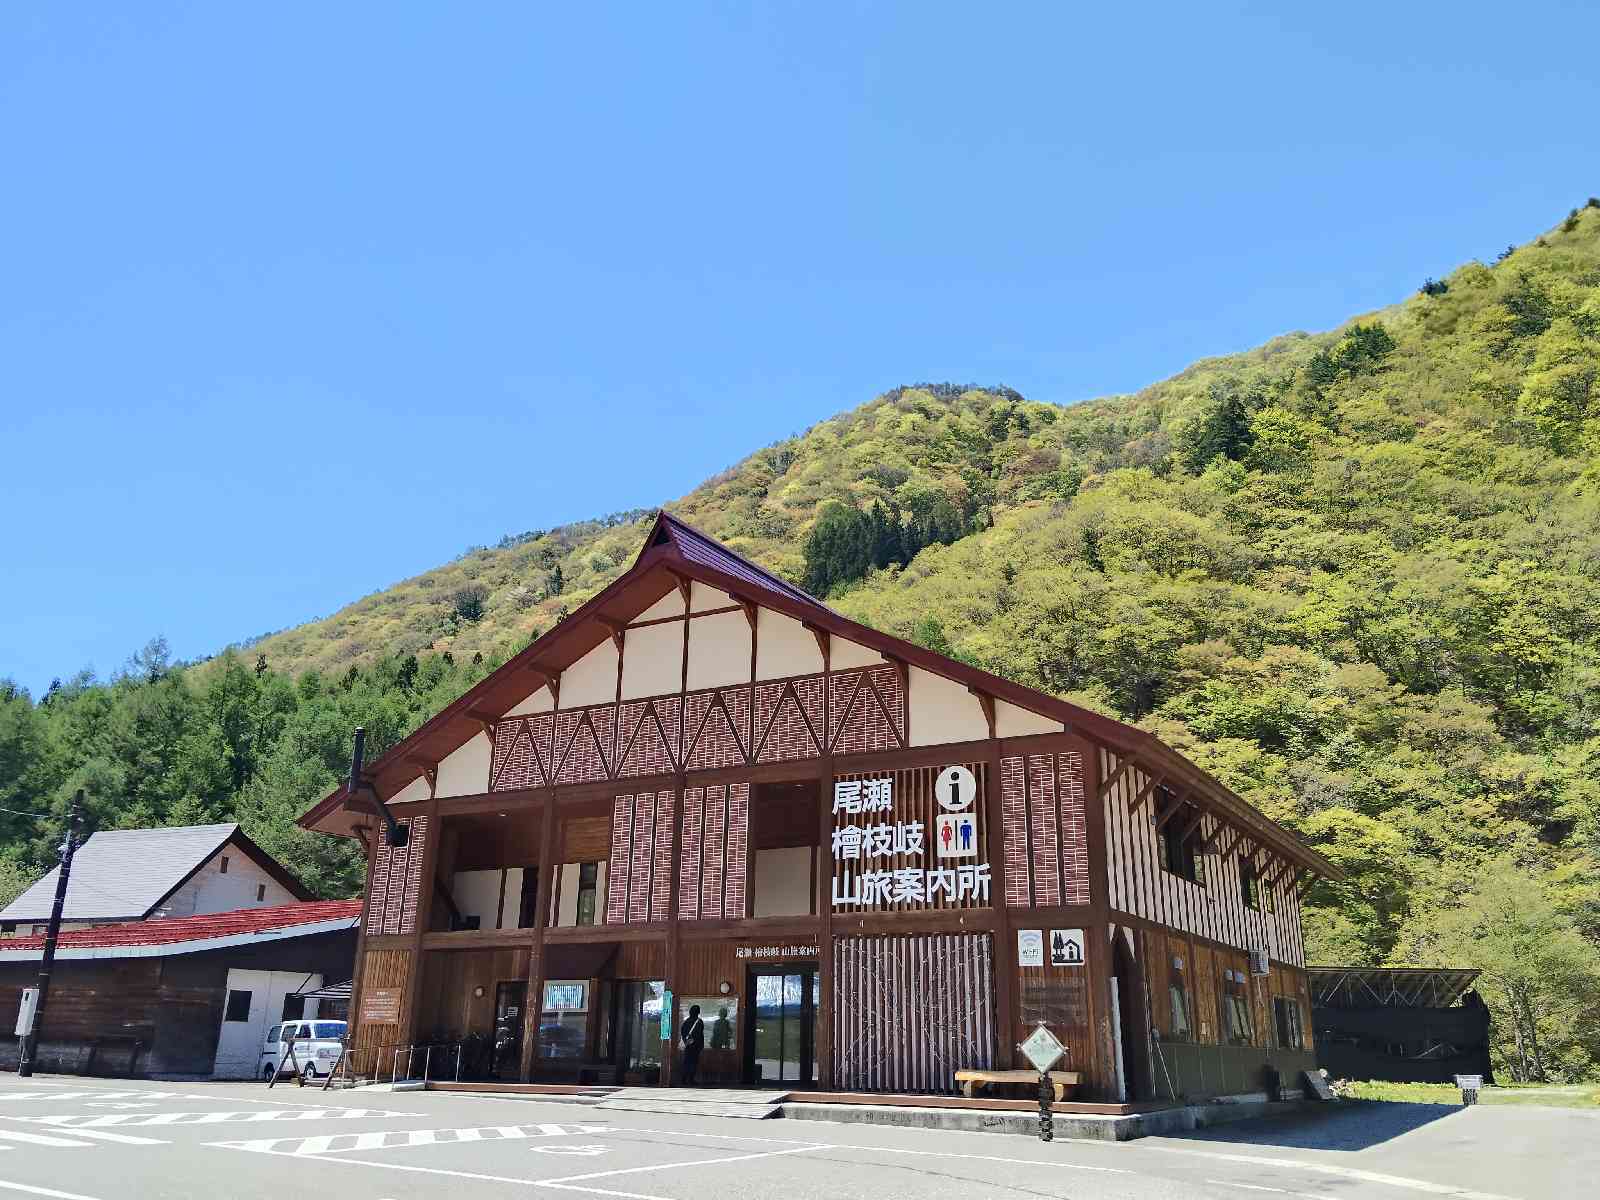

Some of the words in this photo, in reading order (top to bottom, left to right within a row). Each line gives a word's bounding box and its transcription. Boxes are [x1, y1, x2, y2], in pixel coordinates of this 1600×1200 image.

[832, 777, 893, 816] 尾瀬
[832, 819, 925, 860] 檜枝岐
[831, 863, 992, 907] 山旅案内所
